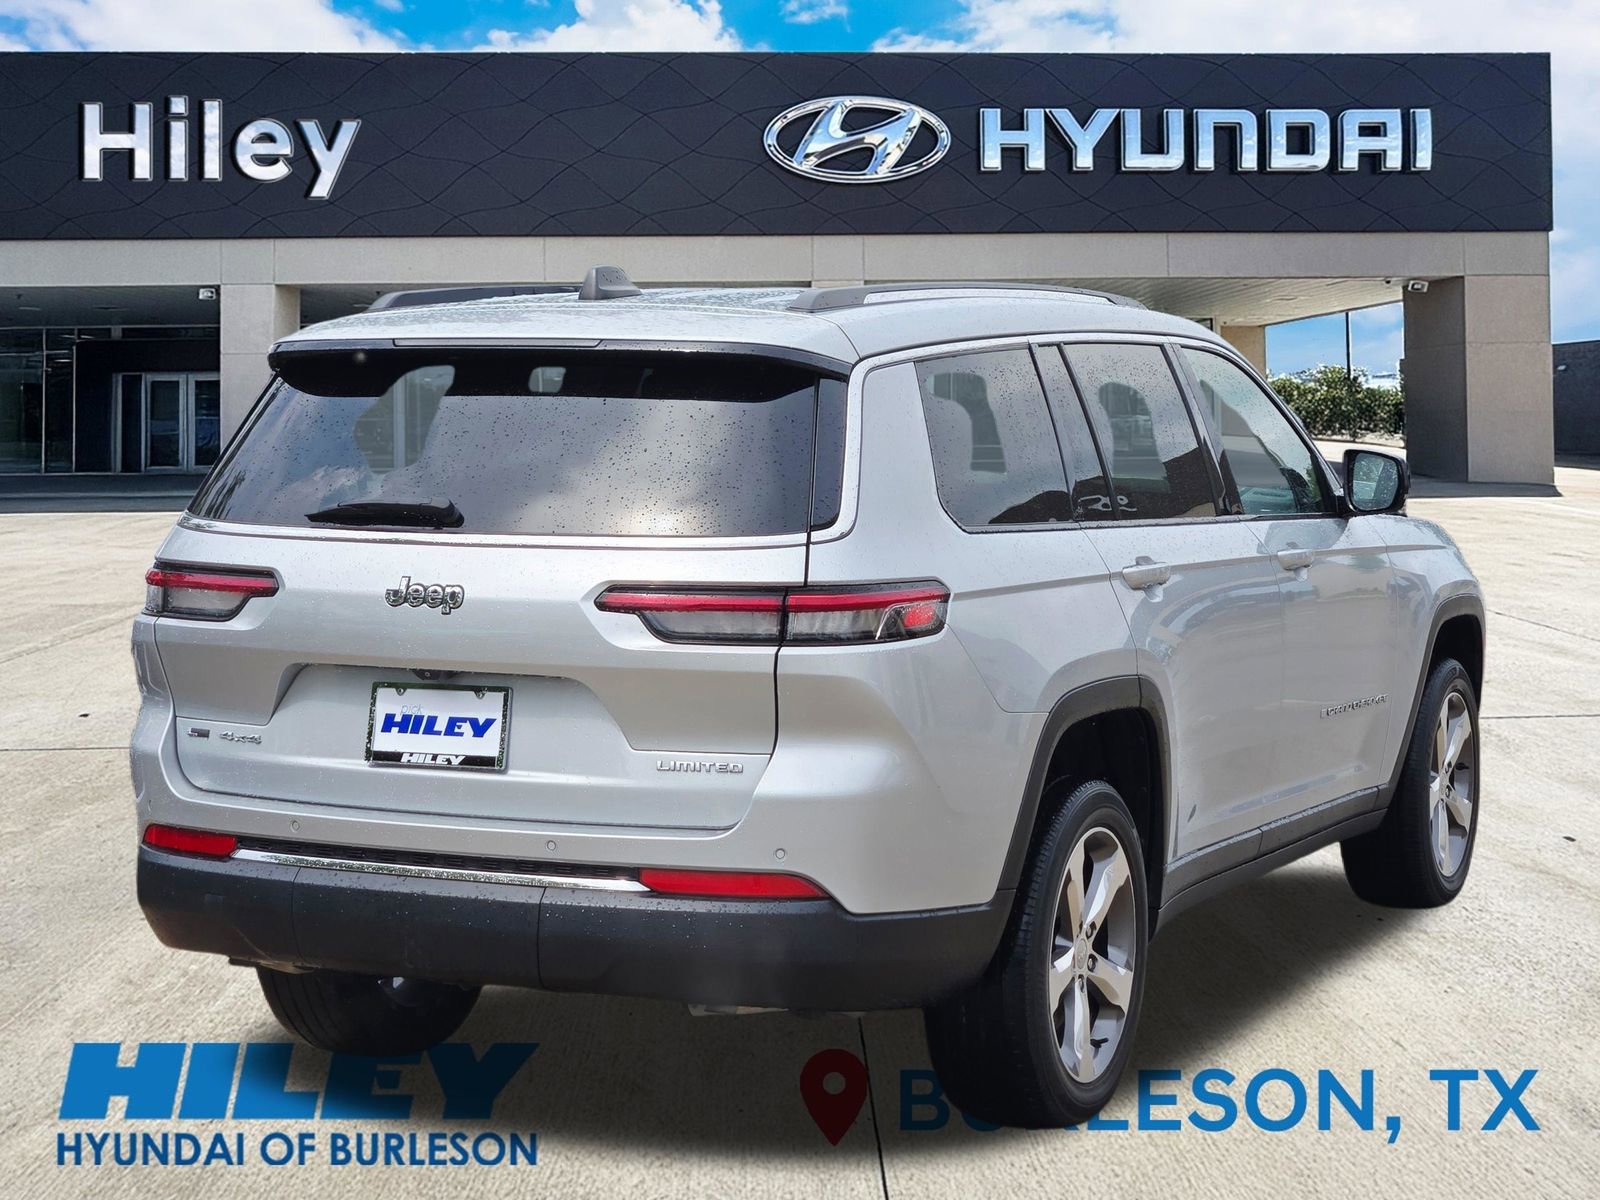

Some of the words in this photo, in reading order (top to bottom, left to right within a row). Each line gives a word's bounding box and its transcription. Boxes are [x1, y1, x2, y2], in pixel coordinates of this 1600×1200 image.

[79, 95, 362, 200] Hiley
[978, 107, 1433, 173] HYUNDAI
[384, 575, 465, 616] Jeep
[380, 712, 497, 738] HILEY
[400, 752, 466, 766] HILEY
[656, 760, 744, 774] LIMITED
